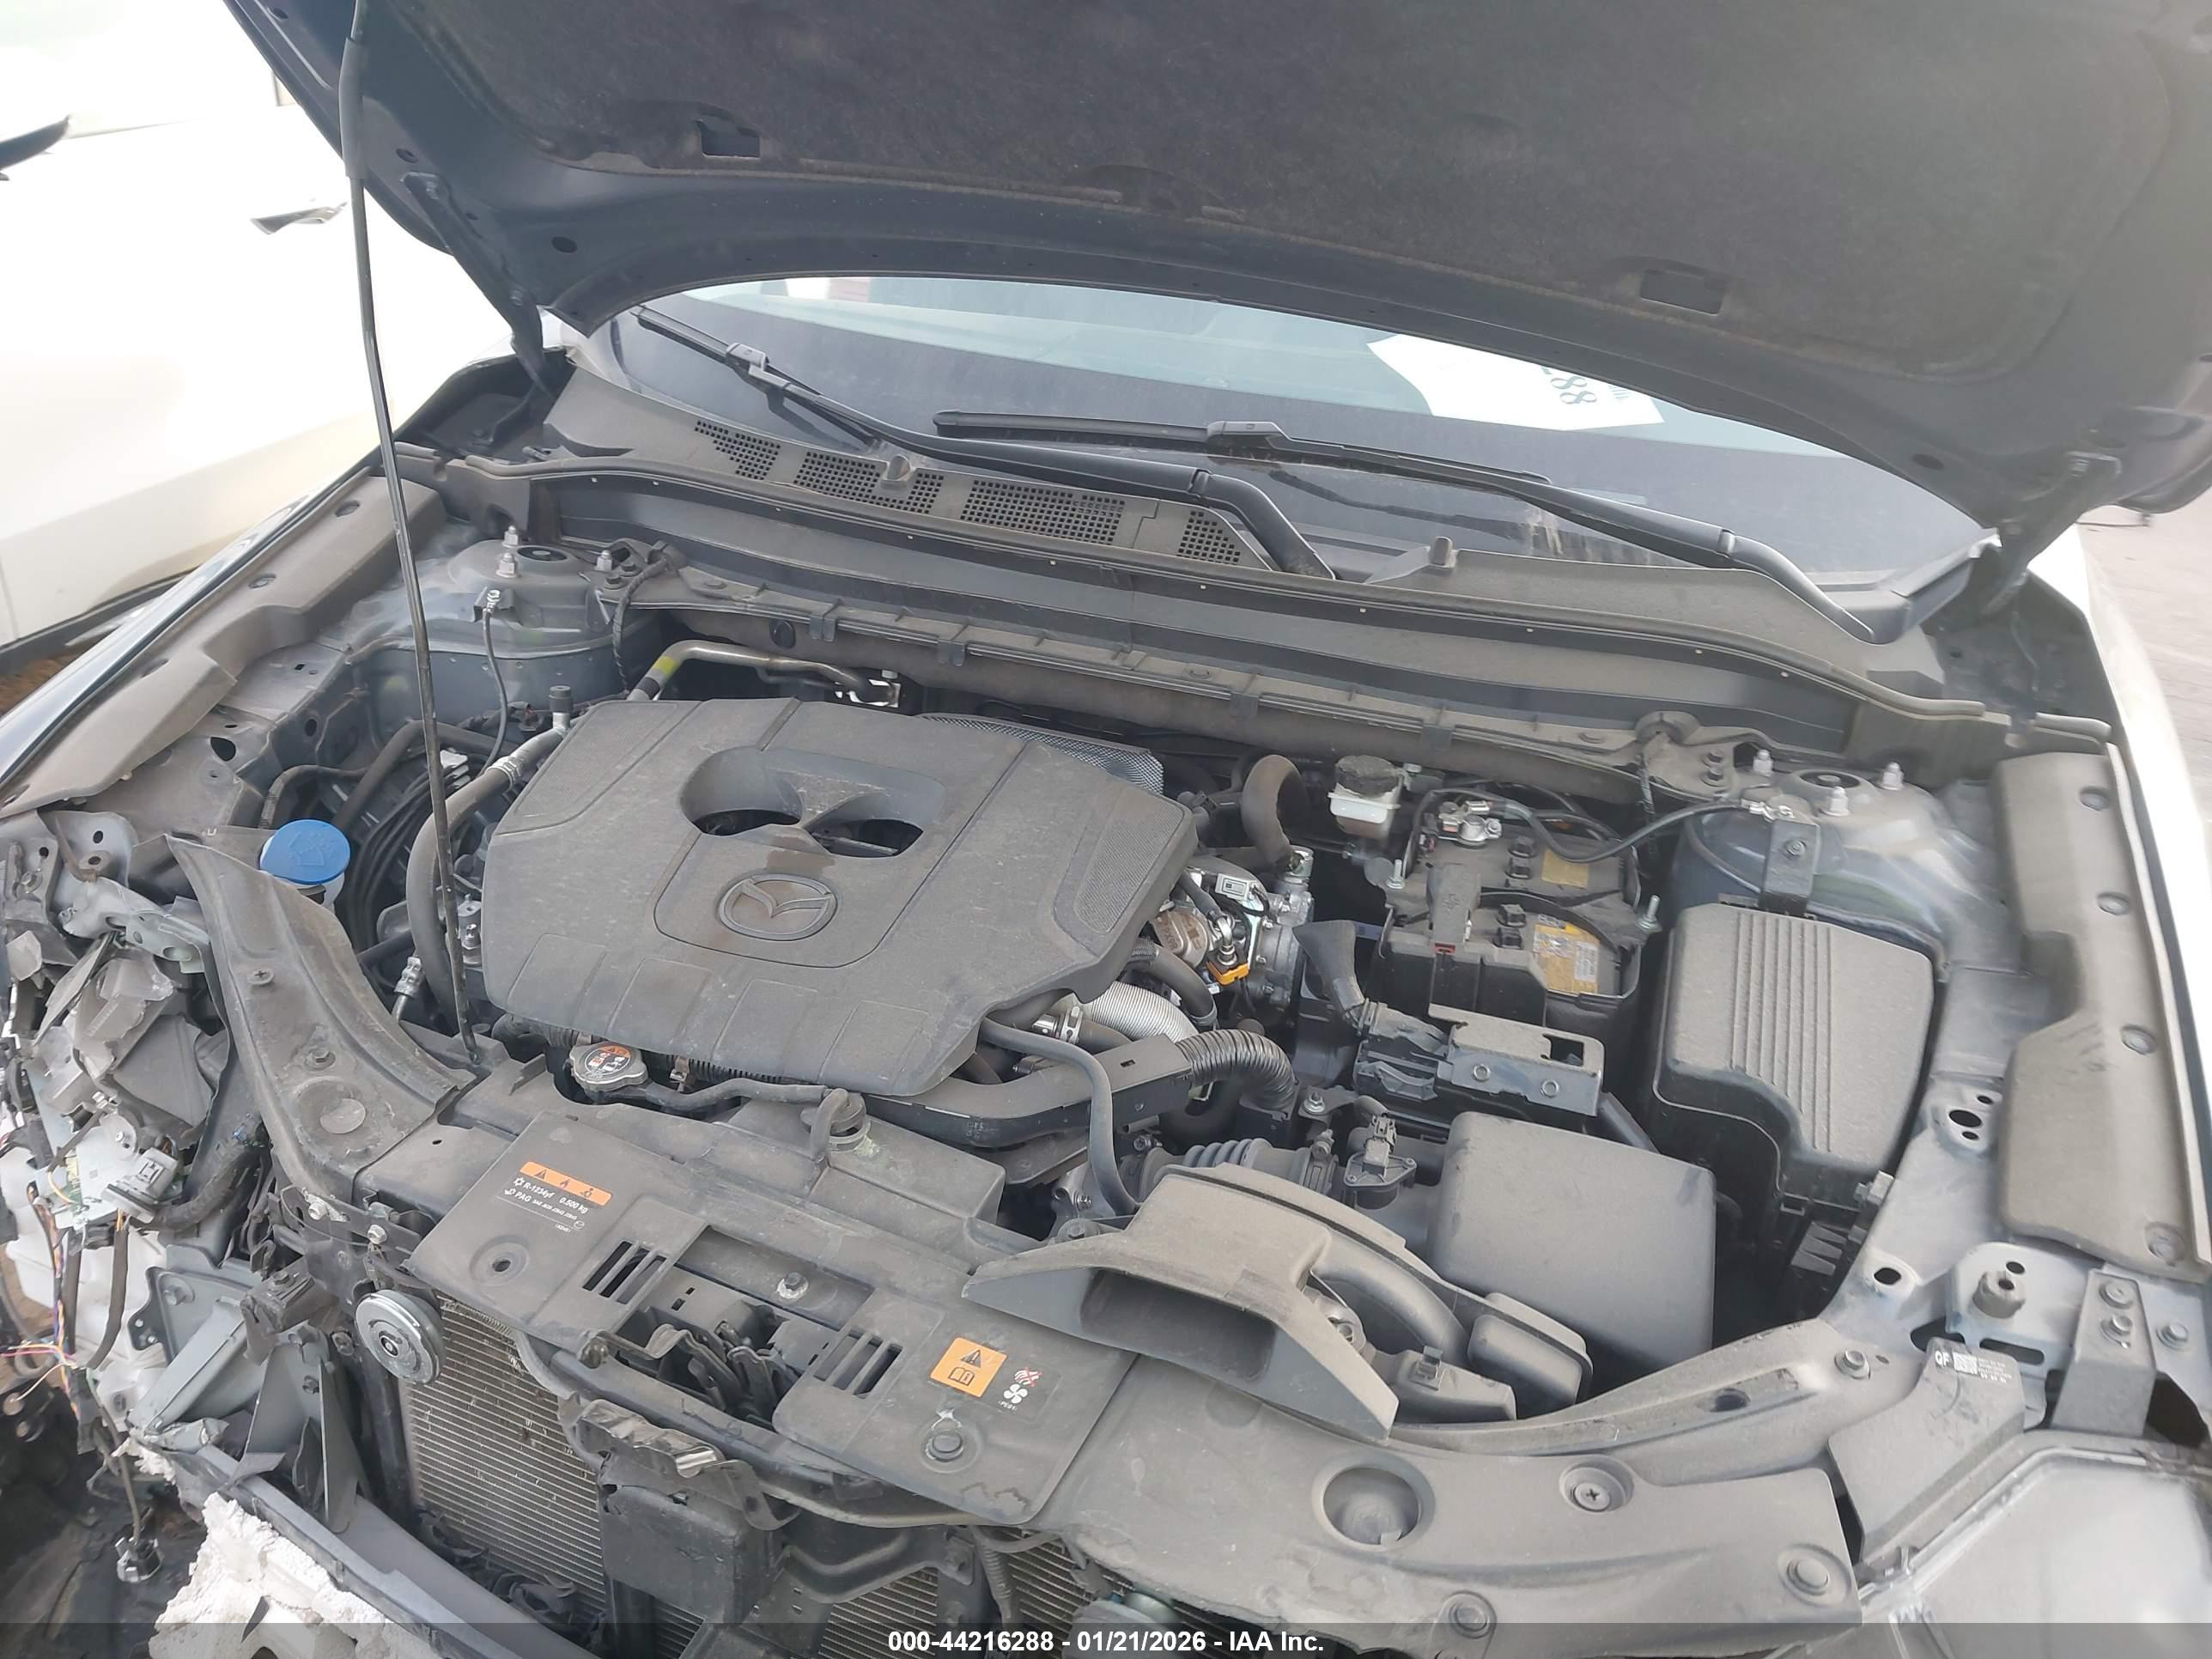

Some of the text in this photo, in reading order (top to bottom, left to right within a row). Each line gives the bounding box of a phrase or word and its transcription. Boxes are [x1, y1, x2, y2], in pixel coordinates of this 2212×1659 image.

[514, 1191, 532, 1202] PAG
[523, 1182, 588, 1214] R-1234yf 0.500 kg
